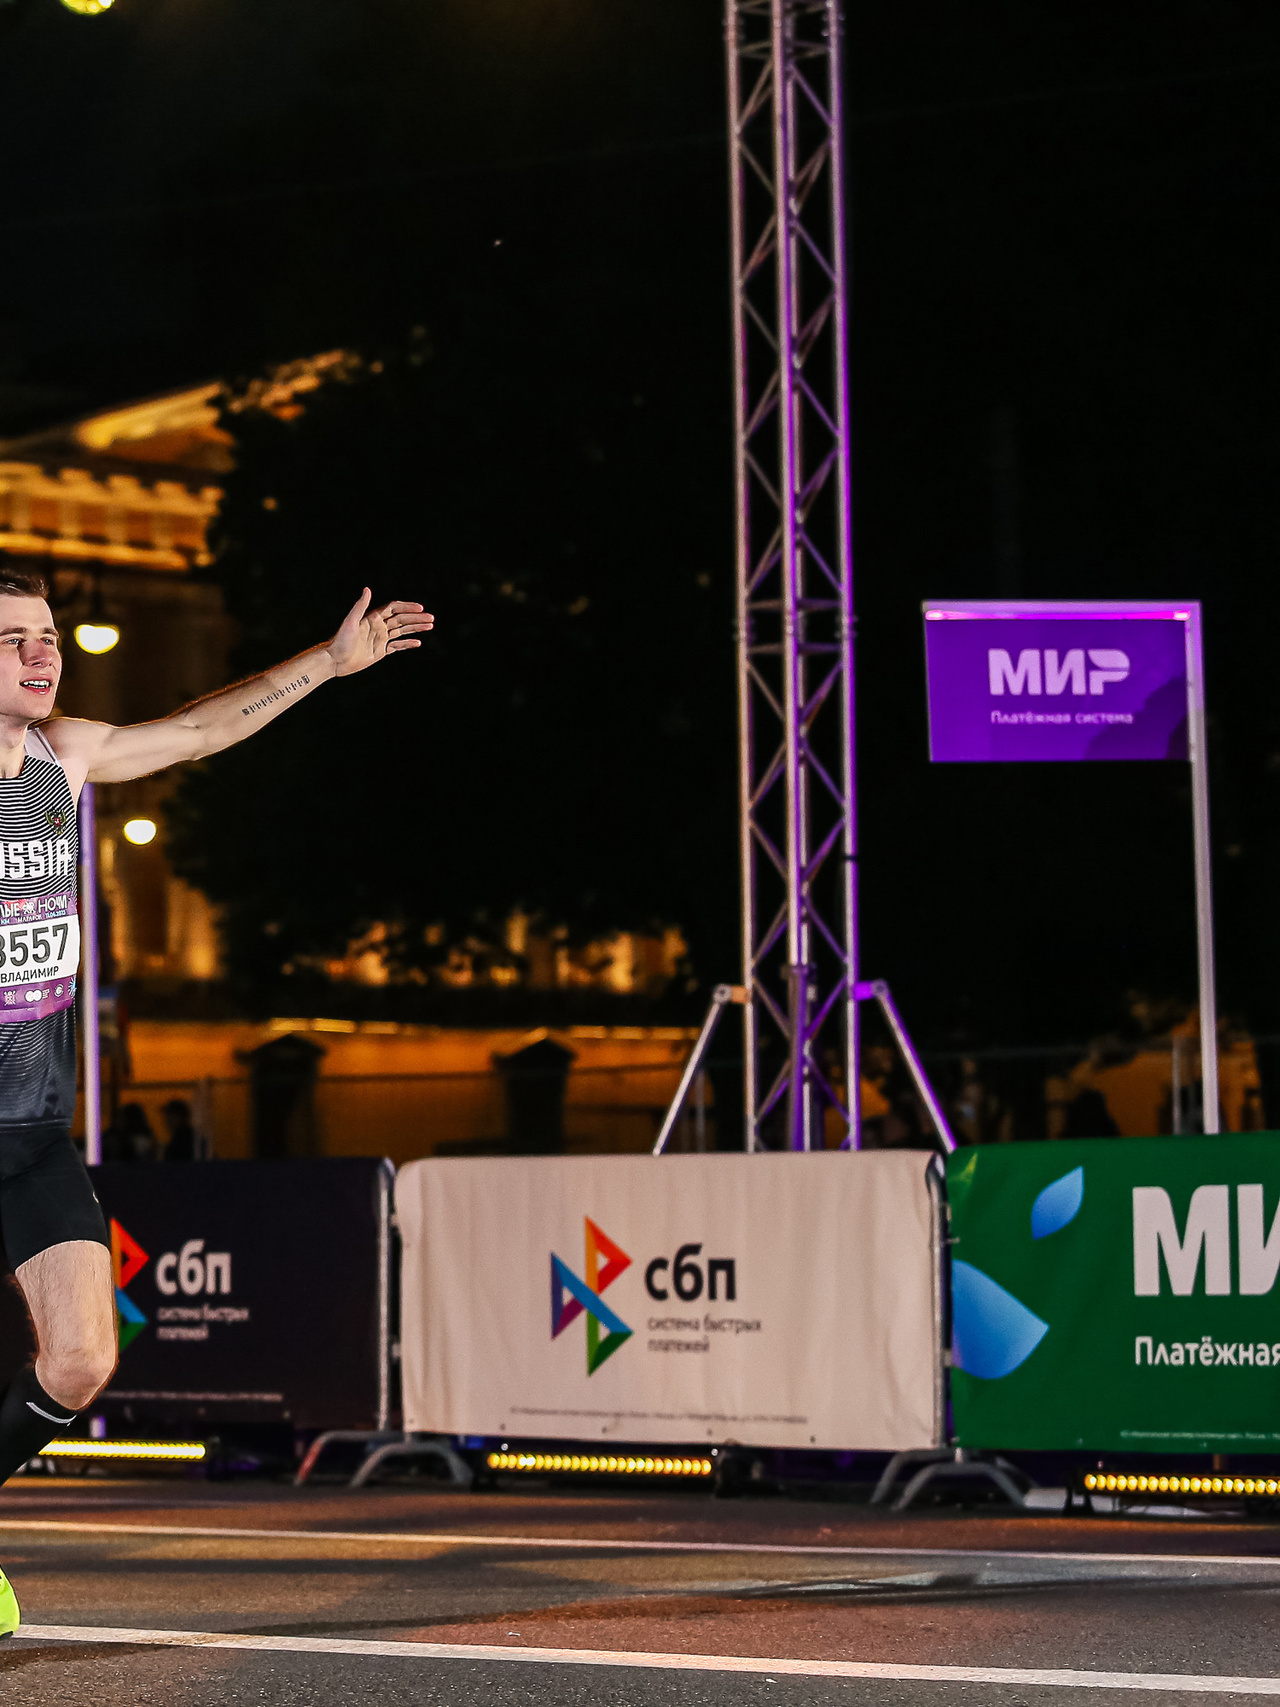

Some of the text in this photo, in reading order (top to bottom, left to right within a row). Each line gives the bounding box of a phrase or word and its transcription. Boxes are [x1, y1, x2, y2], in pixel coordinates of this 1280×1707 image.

[988, 648, 1130, 696] МИР
[991, 709, 1133, 725] Платёжная система
[38, 894, 68, 913] НОЧИ
[0, 965, 59, 984] ВЛАДИМИР
[1135, 1336, 1280, 1366] Платёжная
